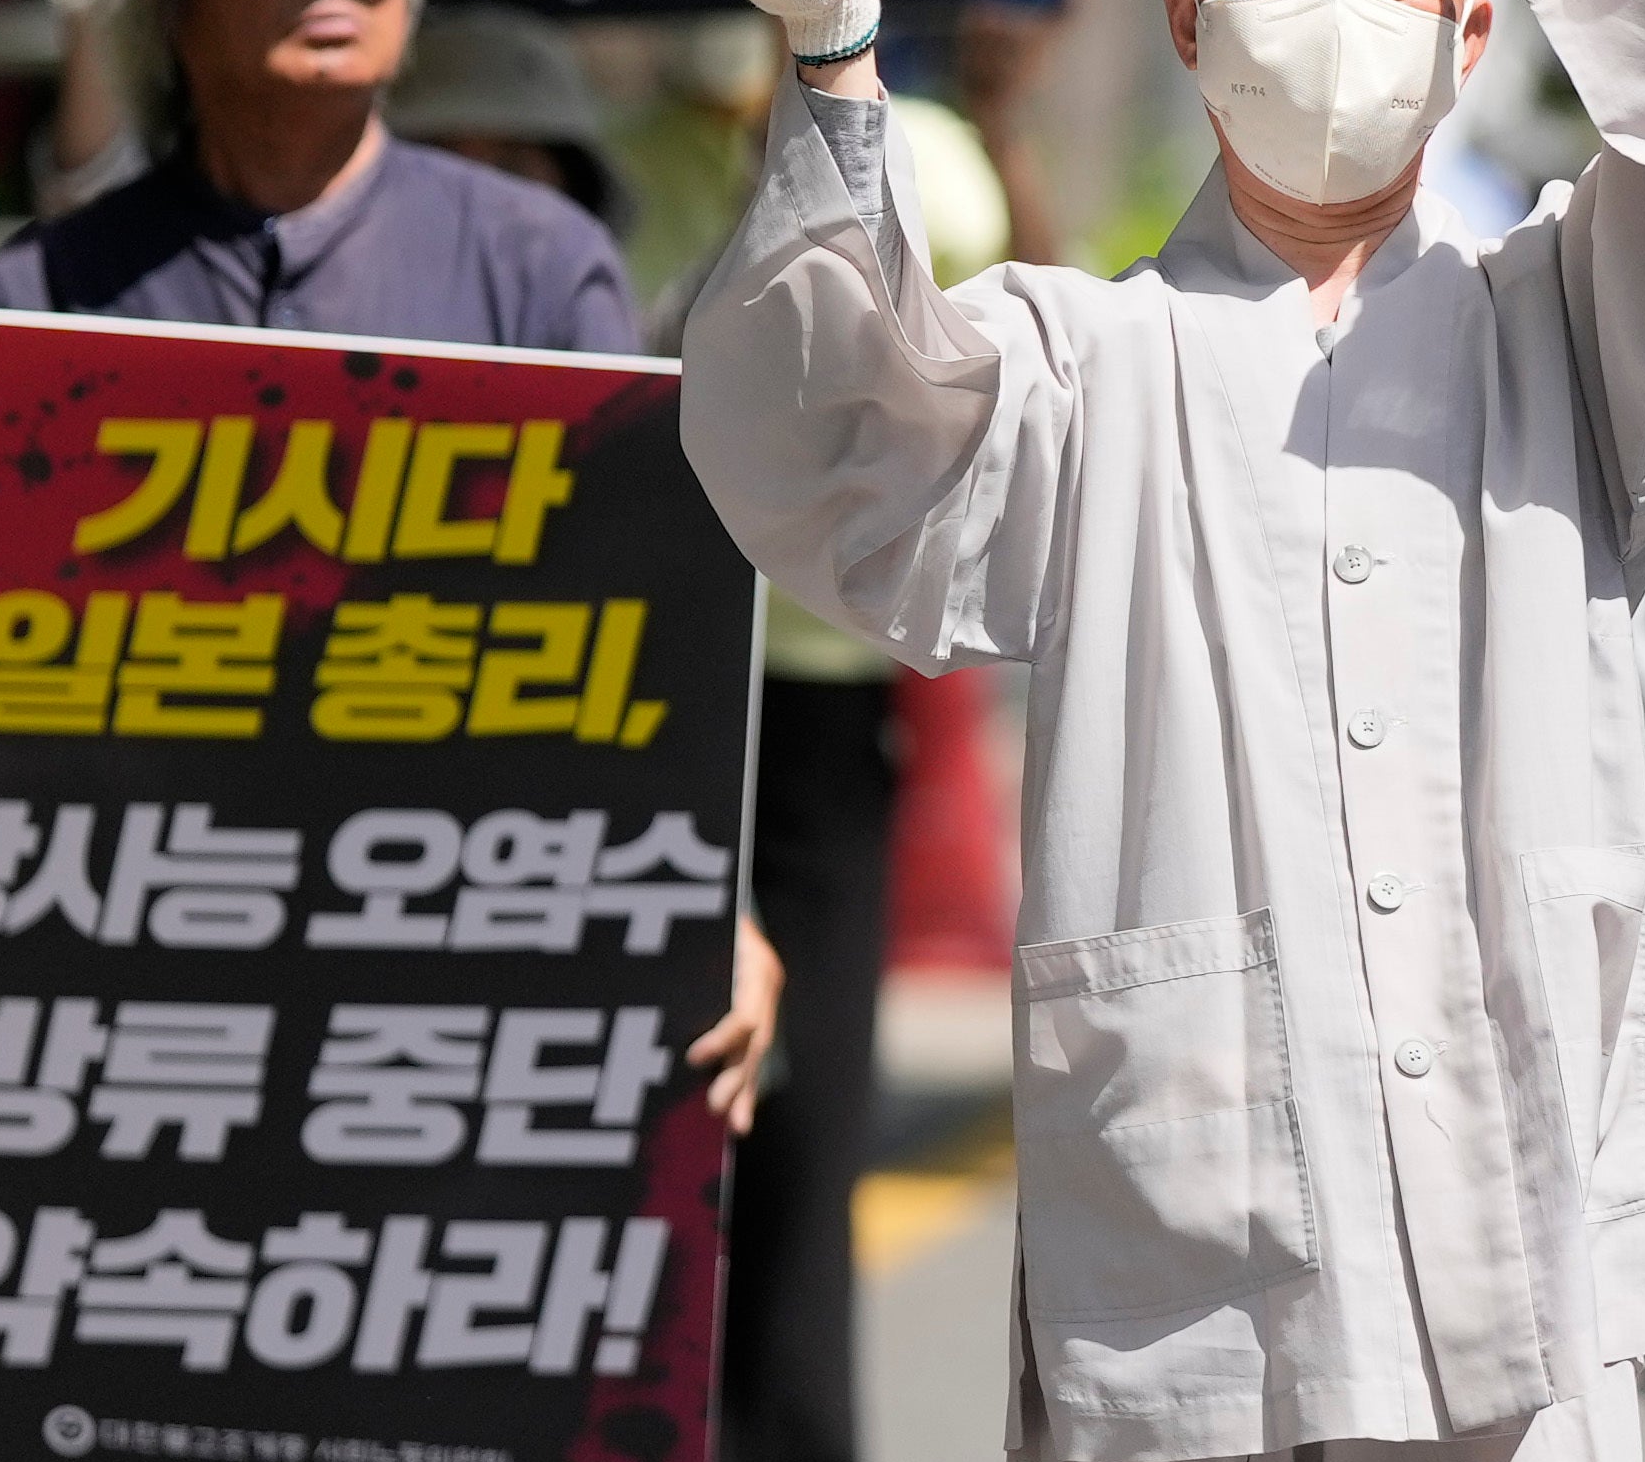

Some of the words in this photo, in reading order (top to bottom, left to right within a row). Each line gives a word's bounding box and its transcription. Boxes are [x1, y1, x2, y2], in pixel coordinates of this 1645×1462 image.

[73, 416, 575, 566] 기시다
[310, 593, 668, 748] 총리,
[305, 808, 731, 955] 오염수
[300, 1003, 672, 1166] 중단
